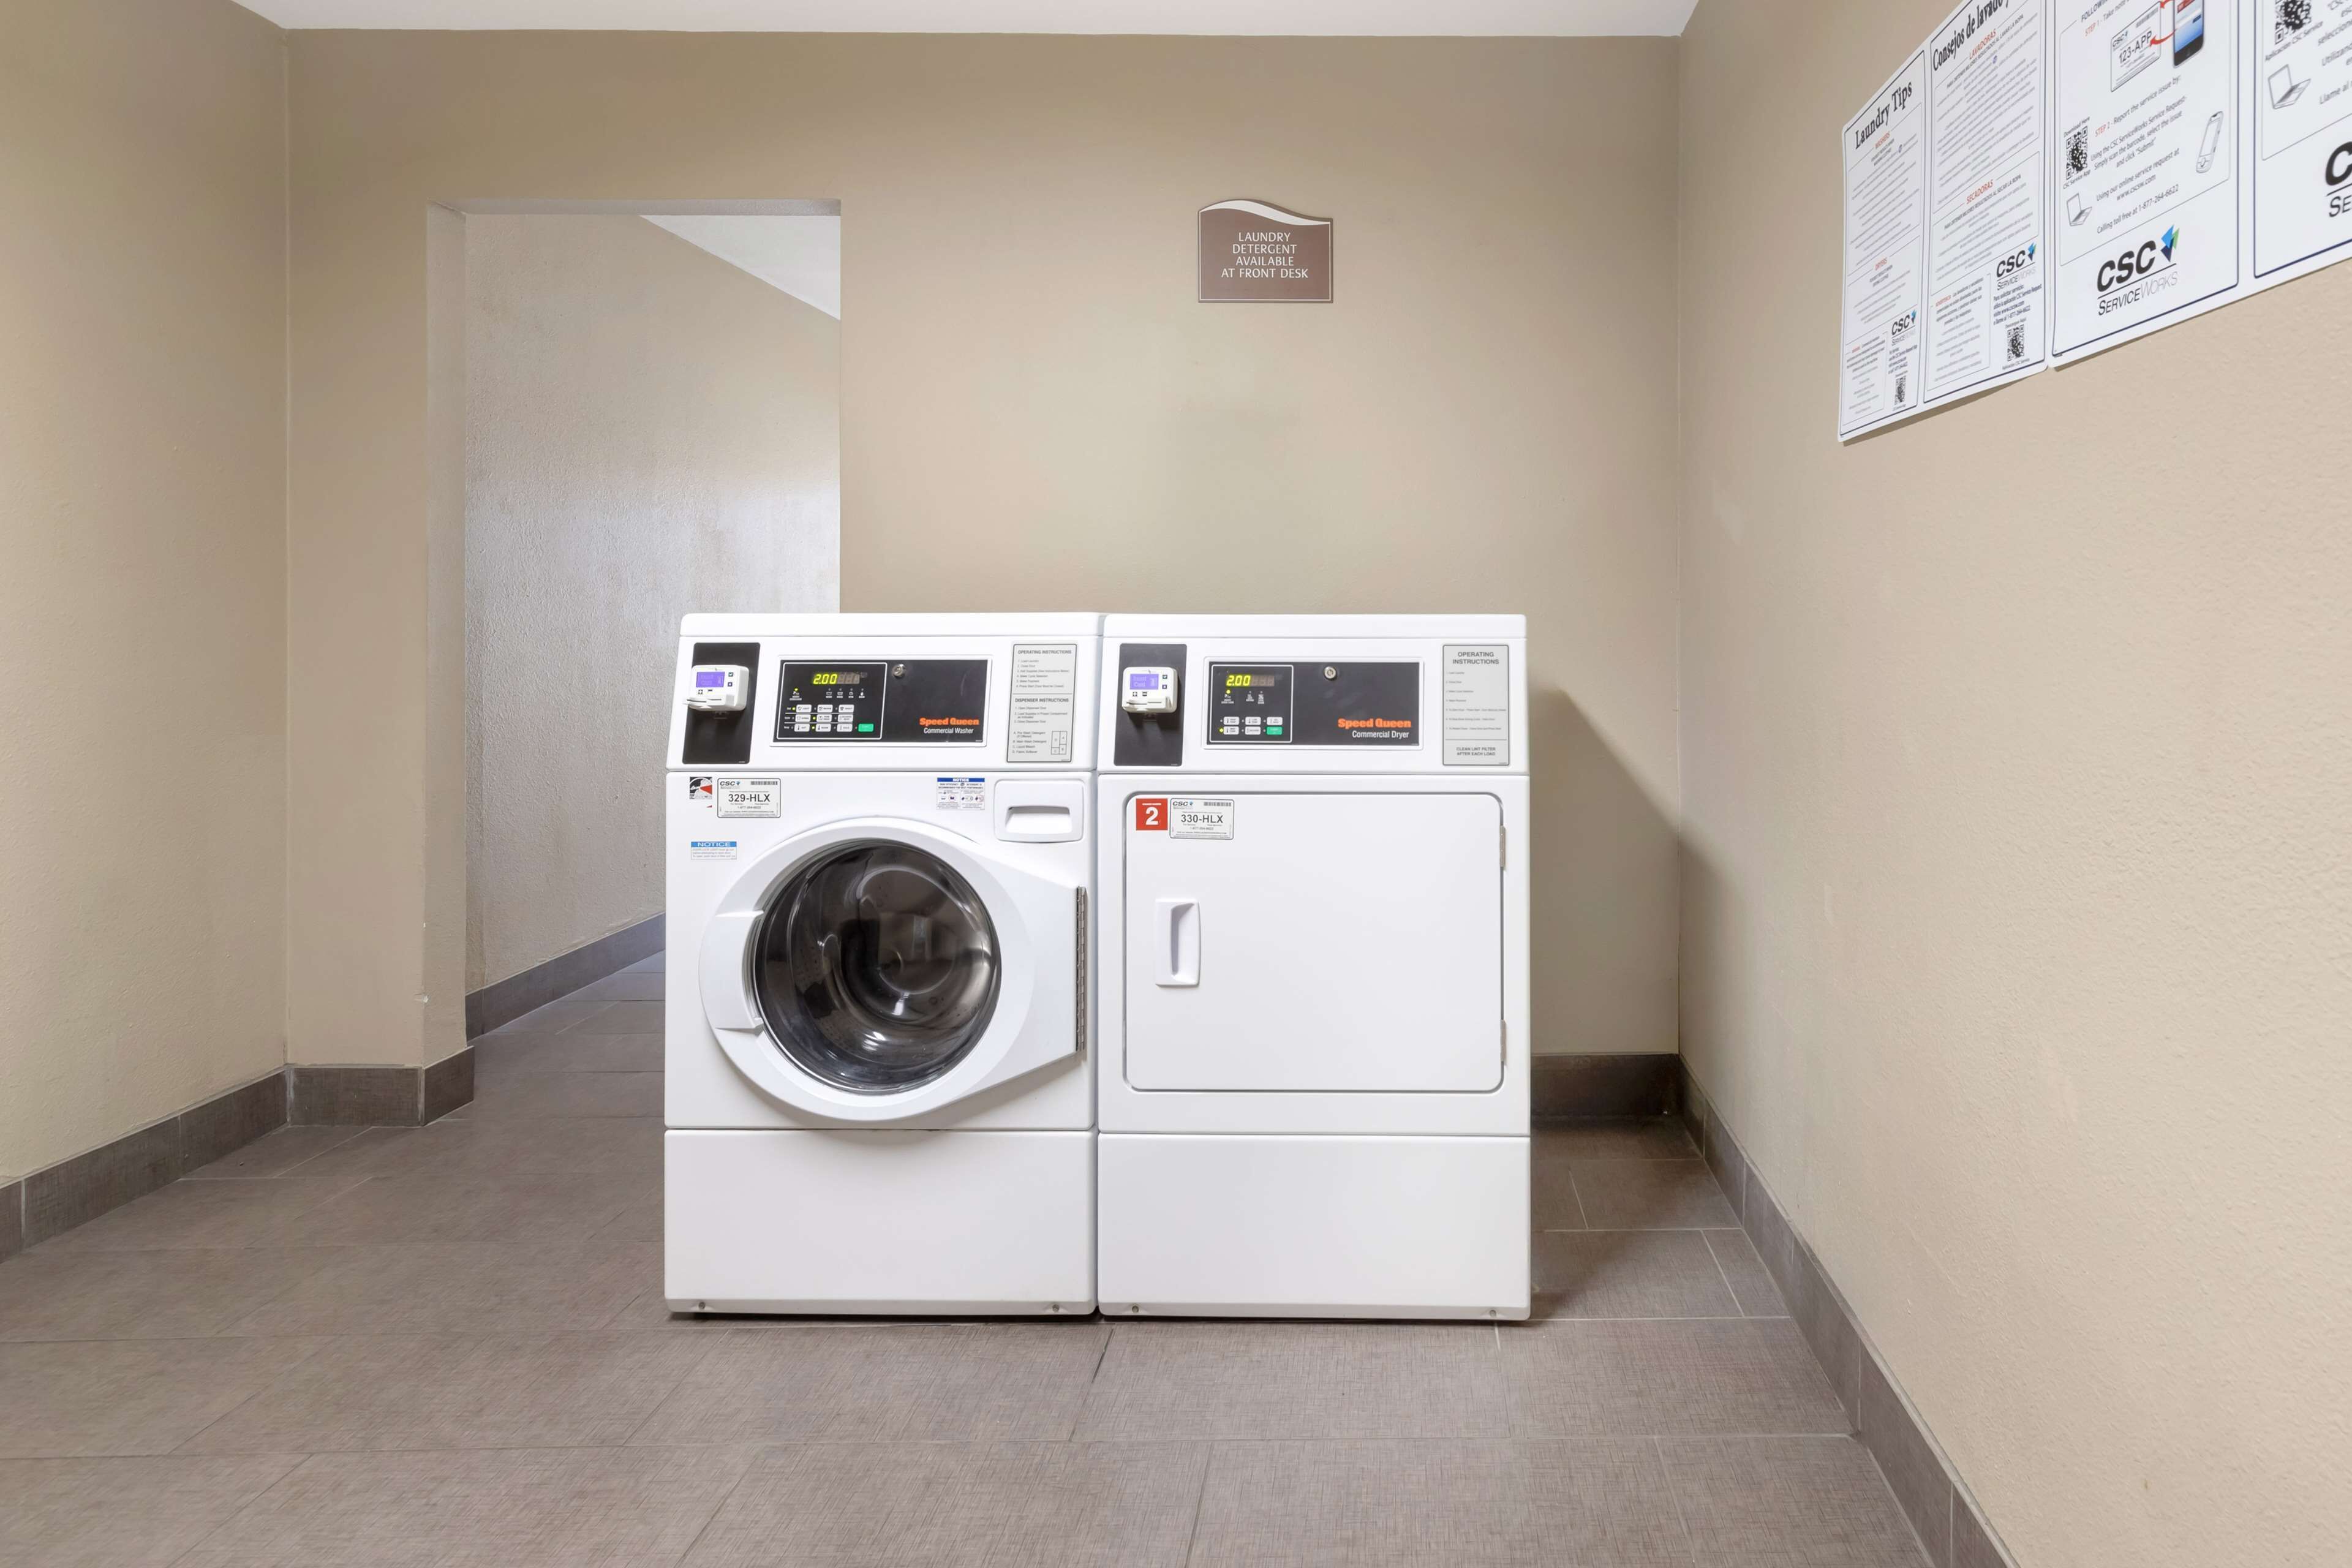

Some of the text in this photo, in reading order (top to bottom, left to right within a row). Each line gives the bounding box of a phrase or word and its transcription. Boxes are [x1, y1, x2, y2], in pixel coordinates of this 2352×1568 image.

[2081, 0, 2107, 23] FOLLOW
[2115, 0, 2129, 11] not
[1933, 28, 1965, 71] Consejos
[1966, 13, 1975, 39] de
[1969, 28, 1997, 59] LAVADORAS
[2119, 30, 2152, 64] 123-APP
[1855, 81, 1912, 149] Laundry Tips
[2095, 124, 2106, 137] STEP
[2113, 109, 2130, 124] Report
[2130, 103, 2139, 115] the
[2139, 91, 2157, 108] service
[2158, 82, 2172, 95] issue
[2148, 110, 2165, 124] Service
[2169, 110, 2182, 123] issue
[2116, 156, 2125, 168] and
[2125, 151, 2135, 164] click
[2097, 148, 2180, 201] Using our online service request at
[1966, 179, 1994, 205] SECADORAS
[2117, 174, 2156, 201] www.cscsw.com
[2097, 183, 2179, 234] Calling toll free at 1-877-264-6622
[1238, 232, 1291, 242] LAUNDRY
[1232, 244, 1297, 254] DETERGENT
[1235, 256, 1294, 266] AVAILABLE
[1997, 250, 2026, 277] CSC
[2097, 240, 2157, 292] CSC
[1221, 268, 1308, 278] AT FRONT DESK
[2098, 271, 2179, 316] SERVICEWORKS
[1891, 314, 1910, 336] CSC
[813, 674, 838, 684] 2.00
[1226, 675, 1251, 686] 2.00
[919, 718, 949, 726] Speed
[1338, 718, 1412, 729] Speed Queen
[1391, 731, 1409, 739] Dryer
[1145, 807, 1158, 825] 2
[1181, 815, 1223, 823] 330-HLX
